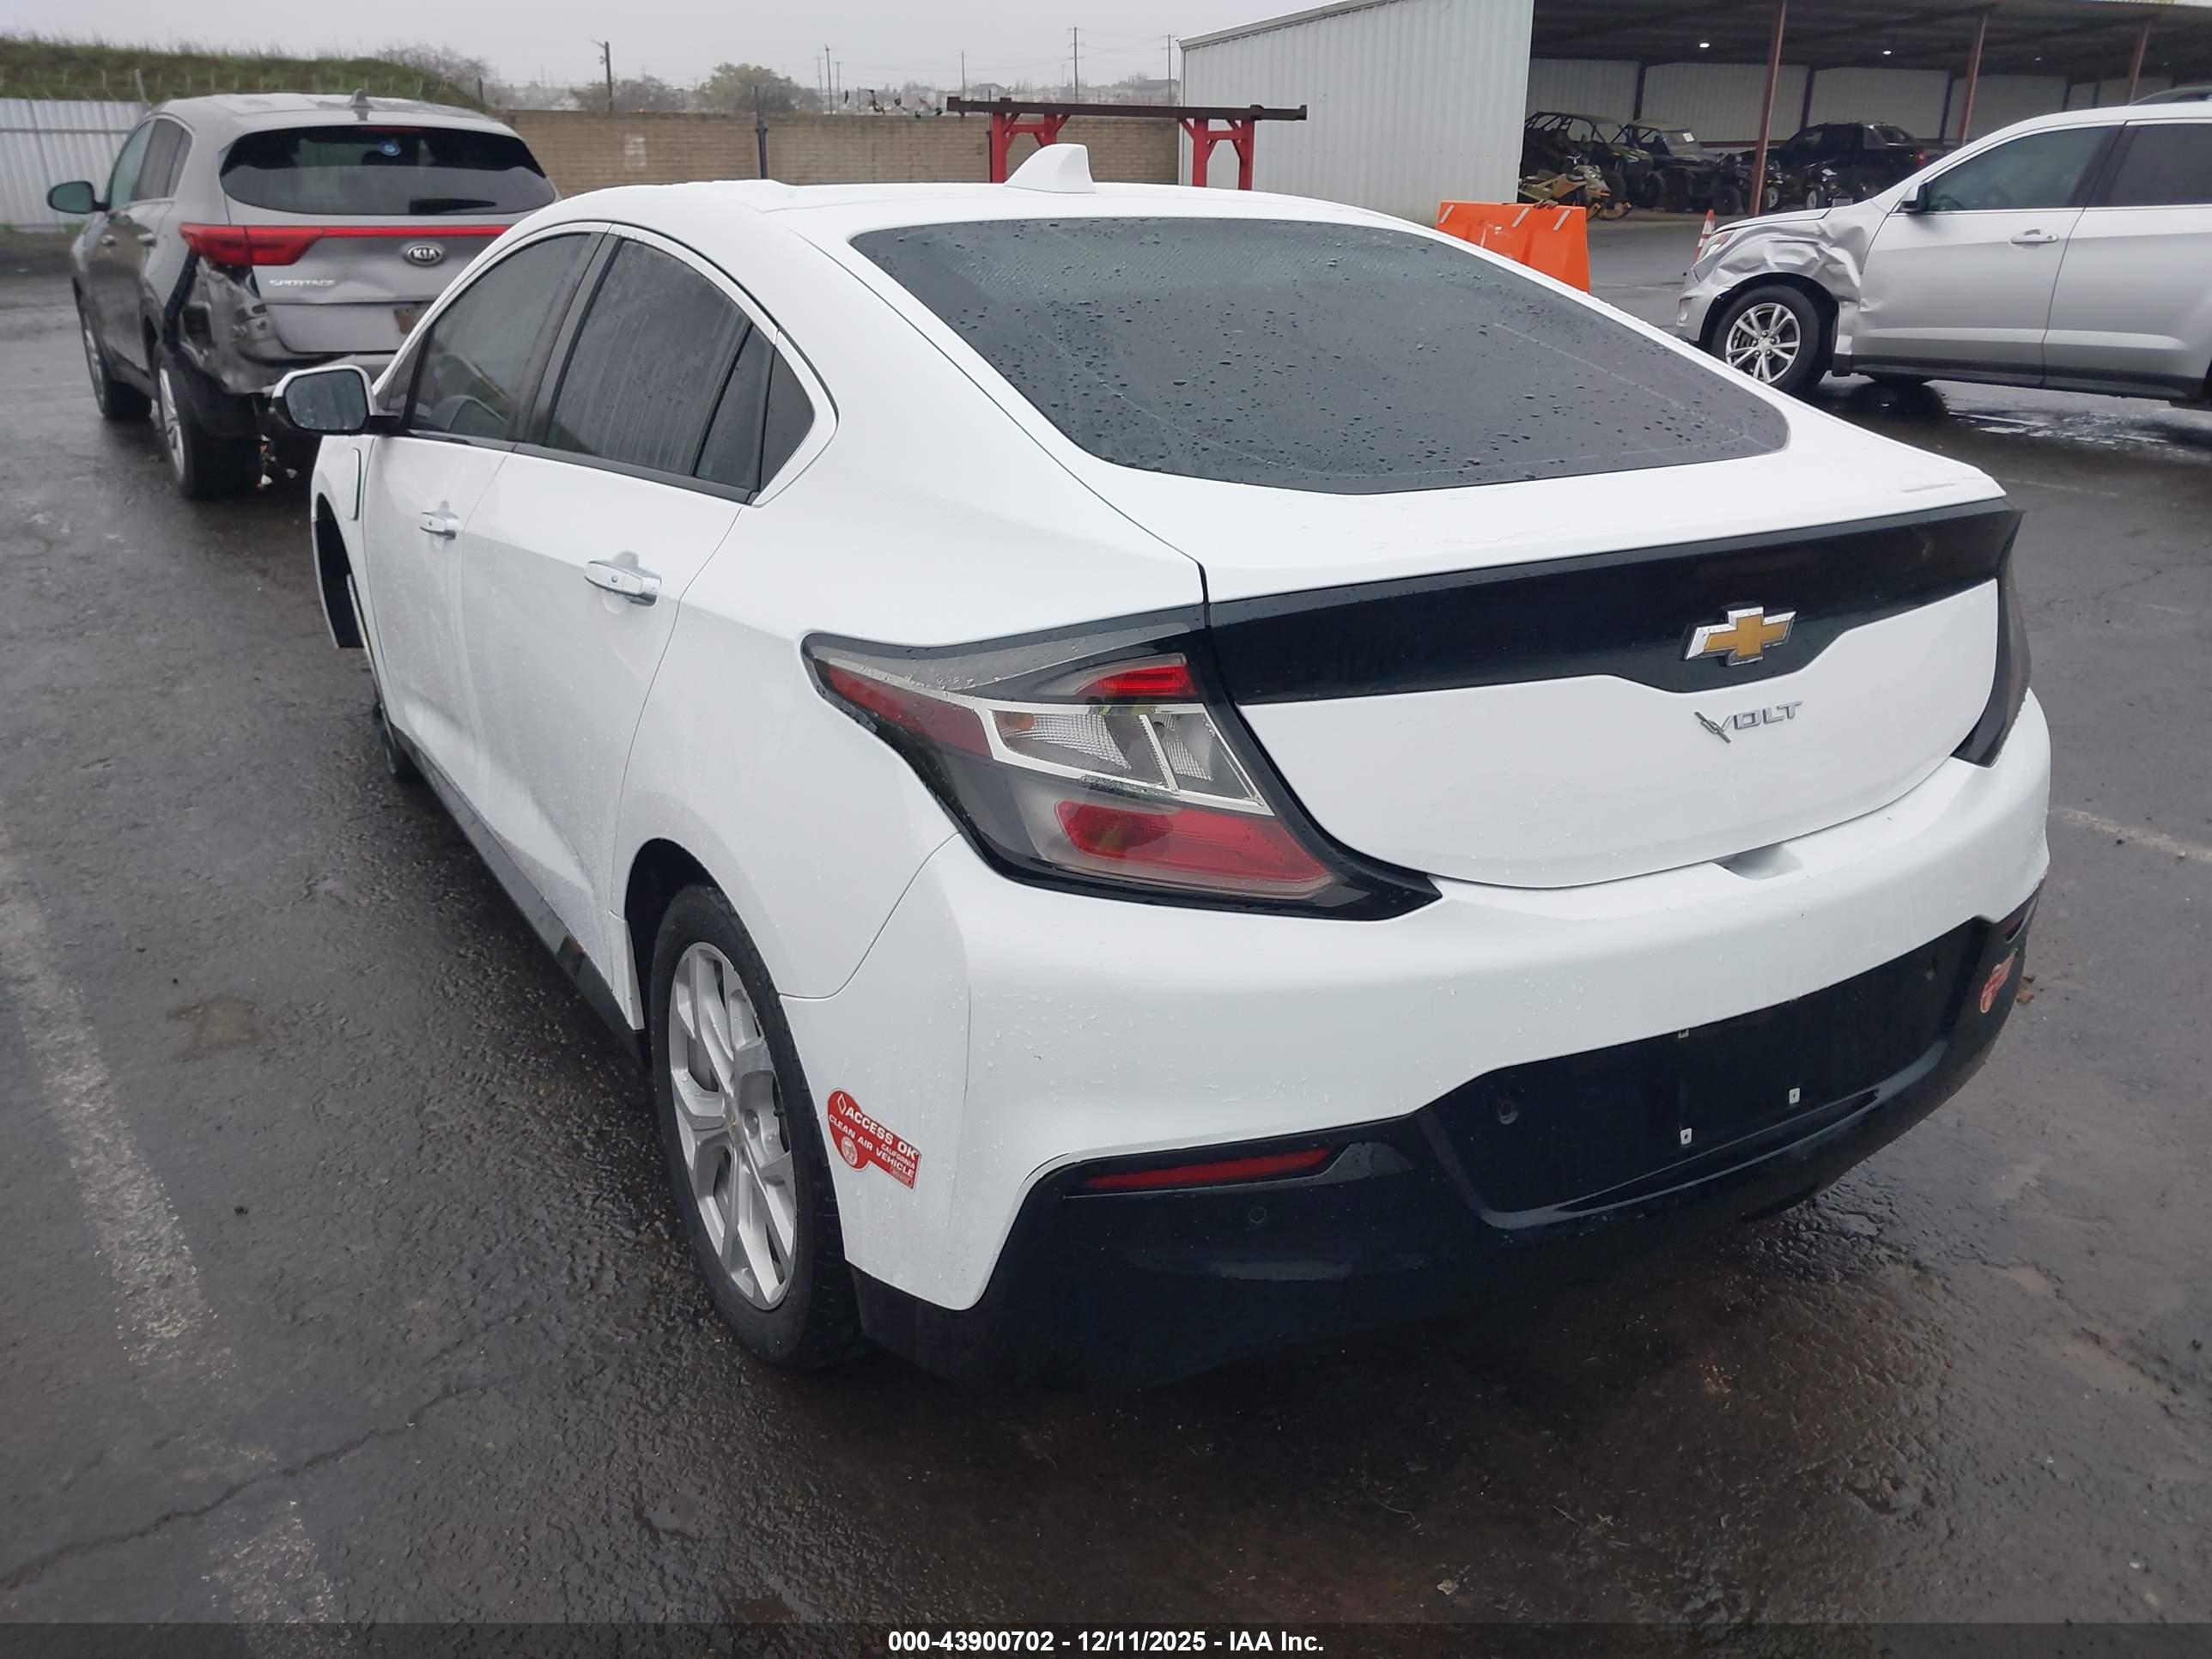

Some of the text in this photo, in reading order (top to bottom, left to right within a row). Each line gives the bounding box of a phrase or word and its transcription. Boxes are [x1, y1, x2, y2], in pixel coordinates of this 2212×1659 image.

[412, 248, 440, 259] KIA
[1694, 701, 1804, 744] VOLT
[829, 1115, 856, 1139] CLEAN
[857, 1135, 873, 1152] AIR
[876, 1147, 915, 1178] VEHICLE
[845, 1106, 920, 1160] ACCESS OK
[881, 1143, 915, 1170] CALIFORNIA
